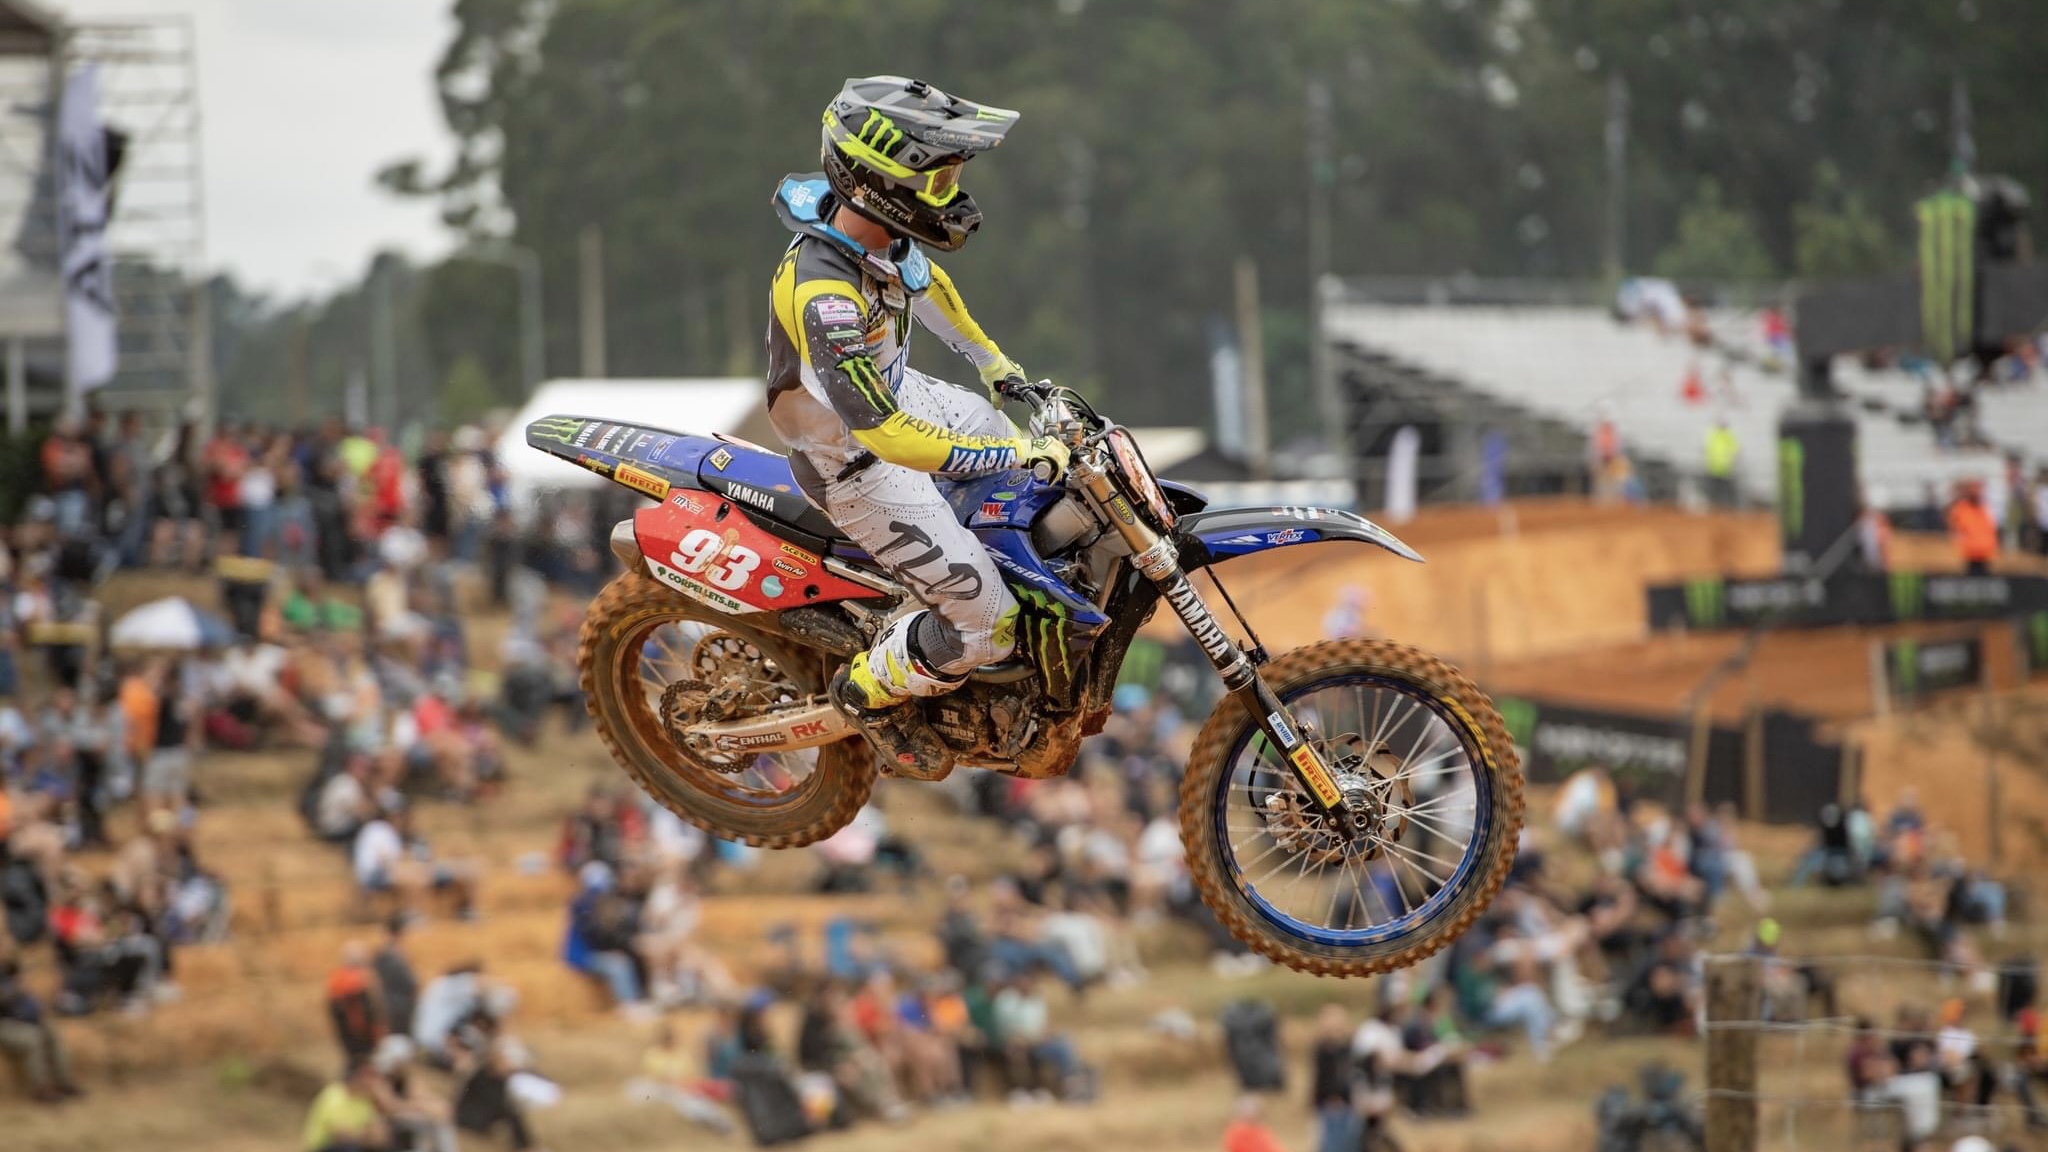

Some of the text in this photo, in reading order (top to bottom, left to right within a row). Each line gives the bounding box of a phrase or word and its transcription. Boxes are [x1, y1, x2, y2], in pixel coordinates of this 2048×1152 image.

[861, 183, 914, 224] MONSTER
[574, 421, 602, 448] YAMAHA
[619, 467, 666, 495] PIRELLI
[726, 481, 775, 512] YAMAHA
[1267, 530, 1304, 545] VERTEX
[670, 529, 761, 591] 93
[774, 559, 805, 577] Twin Air
[781, 545, 817, 564] ACERBIS
[875, 520, 983, 600] TLD
[983, 543, 1055, 583] Z250F
[668, 572, 741, 611] CORPELLETS.BE
[1165, 577, 1230, 660] YAMAHA
[716, 732, 786, 750] RENTHAL
[790, 719, 828, 741] RK
[1298, 750, 1336, 802] PIRELLI
